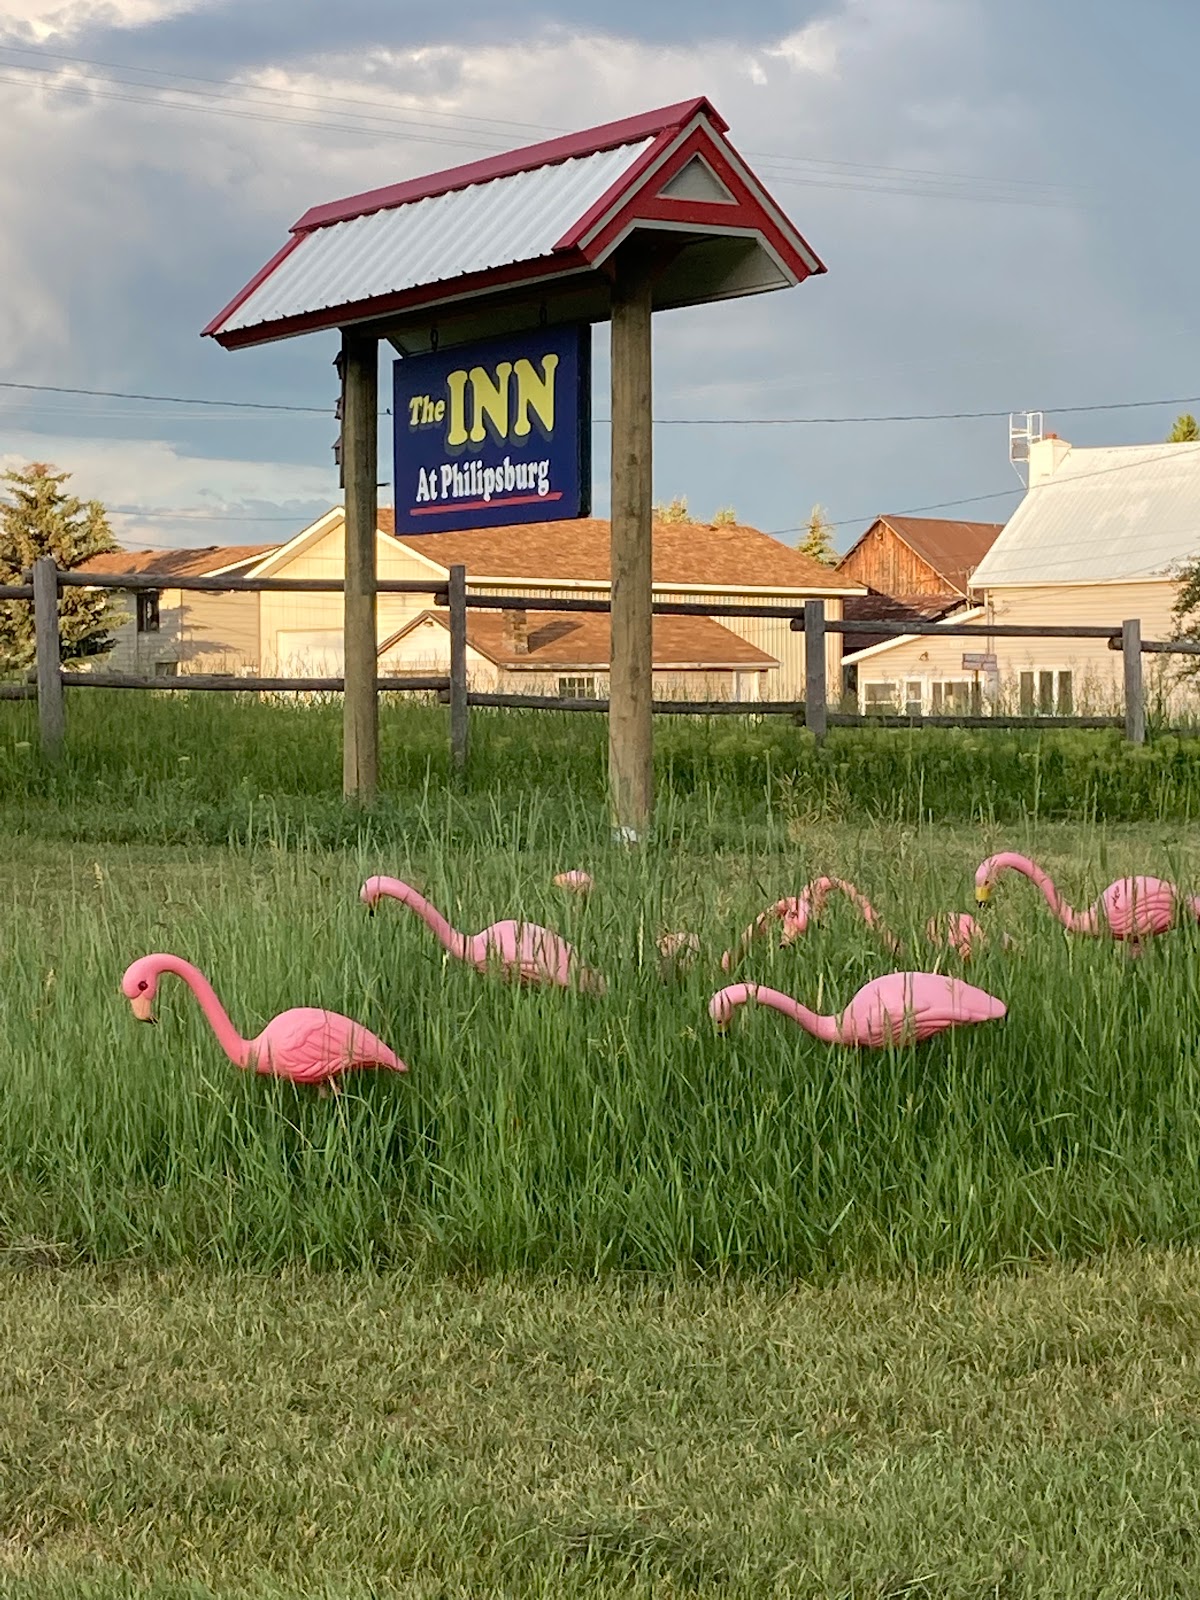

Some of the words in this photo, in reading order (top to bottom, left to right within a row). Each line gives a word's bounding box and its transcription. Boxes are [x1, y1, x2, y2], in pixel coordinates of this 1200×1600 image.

[409, 395, 445, 425] The
[447, 354, 559, 445] INN
[416, 467, 438, 502] At
[440, 456, 549, 502] Philipsburg
